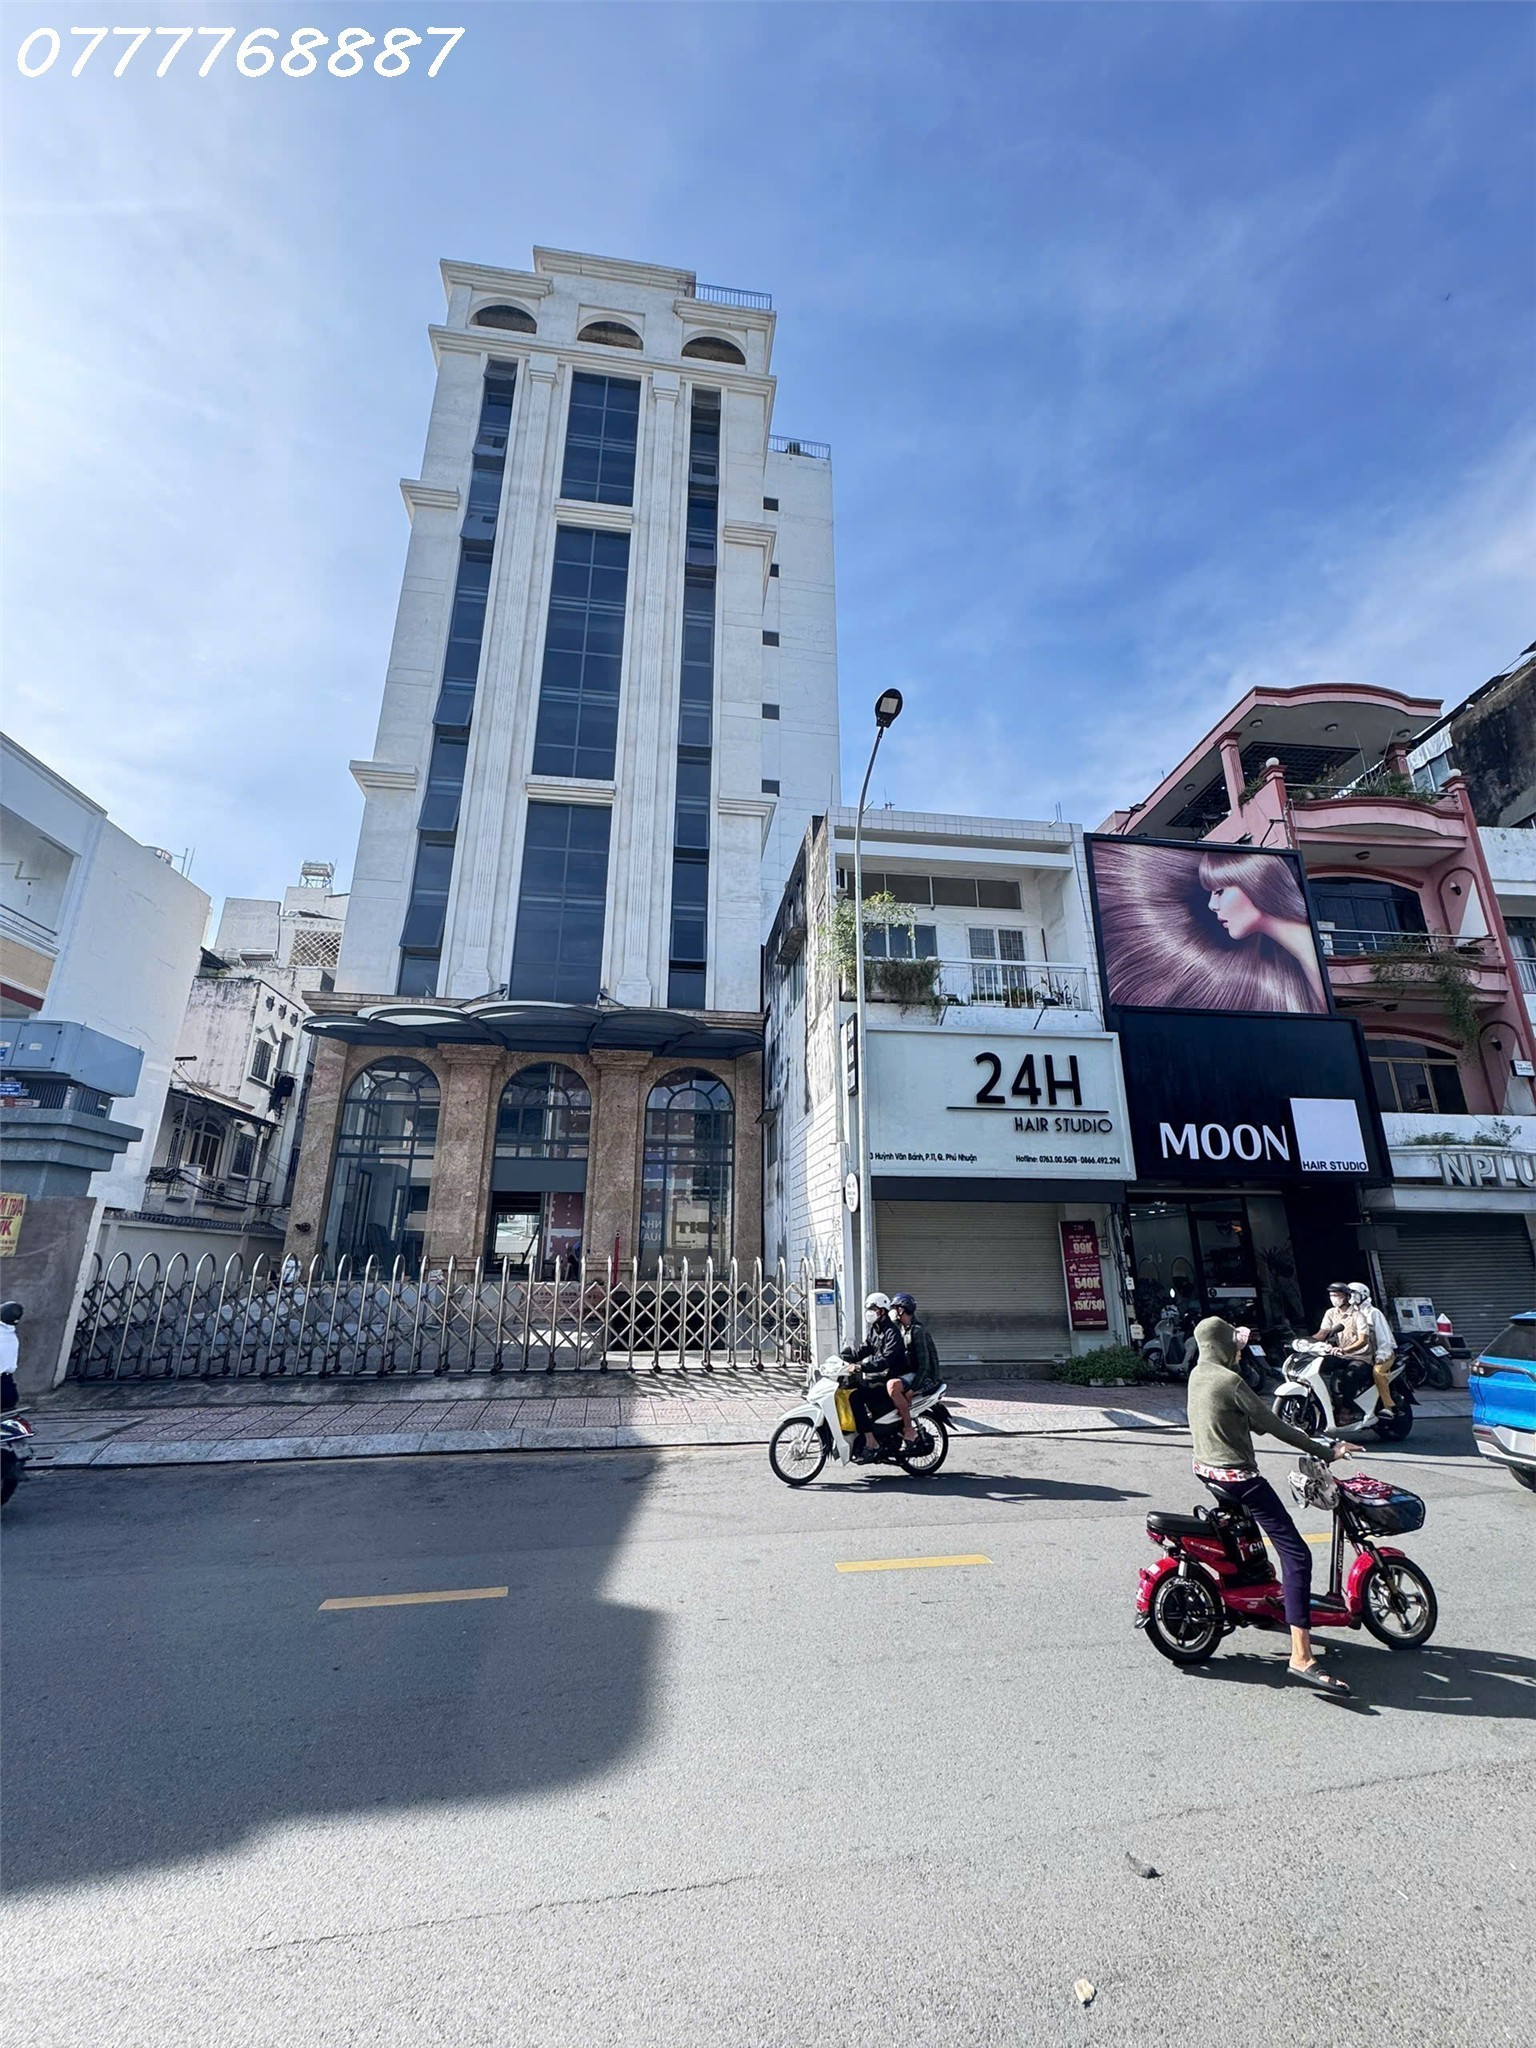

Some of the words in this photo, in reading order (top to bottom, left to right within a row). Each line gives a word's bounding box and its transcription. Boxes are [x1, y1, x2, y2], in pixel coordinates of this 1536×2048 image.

[974, 1051, 1082, 1106] 24H
[1015, 1116, 1049, 1132] HAIR
[1054, 1118, 1113, 1134] STUDIO
[1159, 1122, 1290, 1161] MOON
[1302, 1161, 1328, 1171] HAIR
[1329, 1161, 1367, 1171] STUDIO
